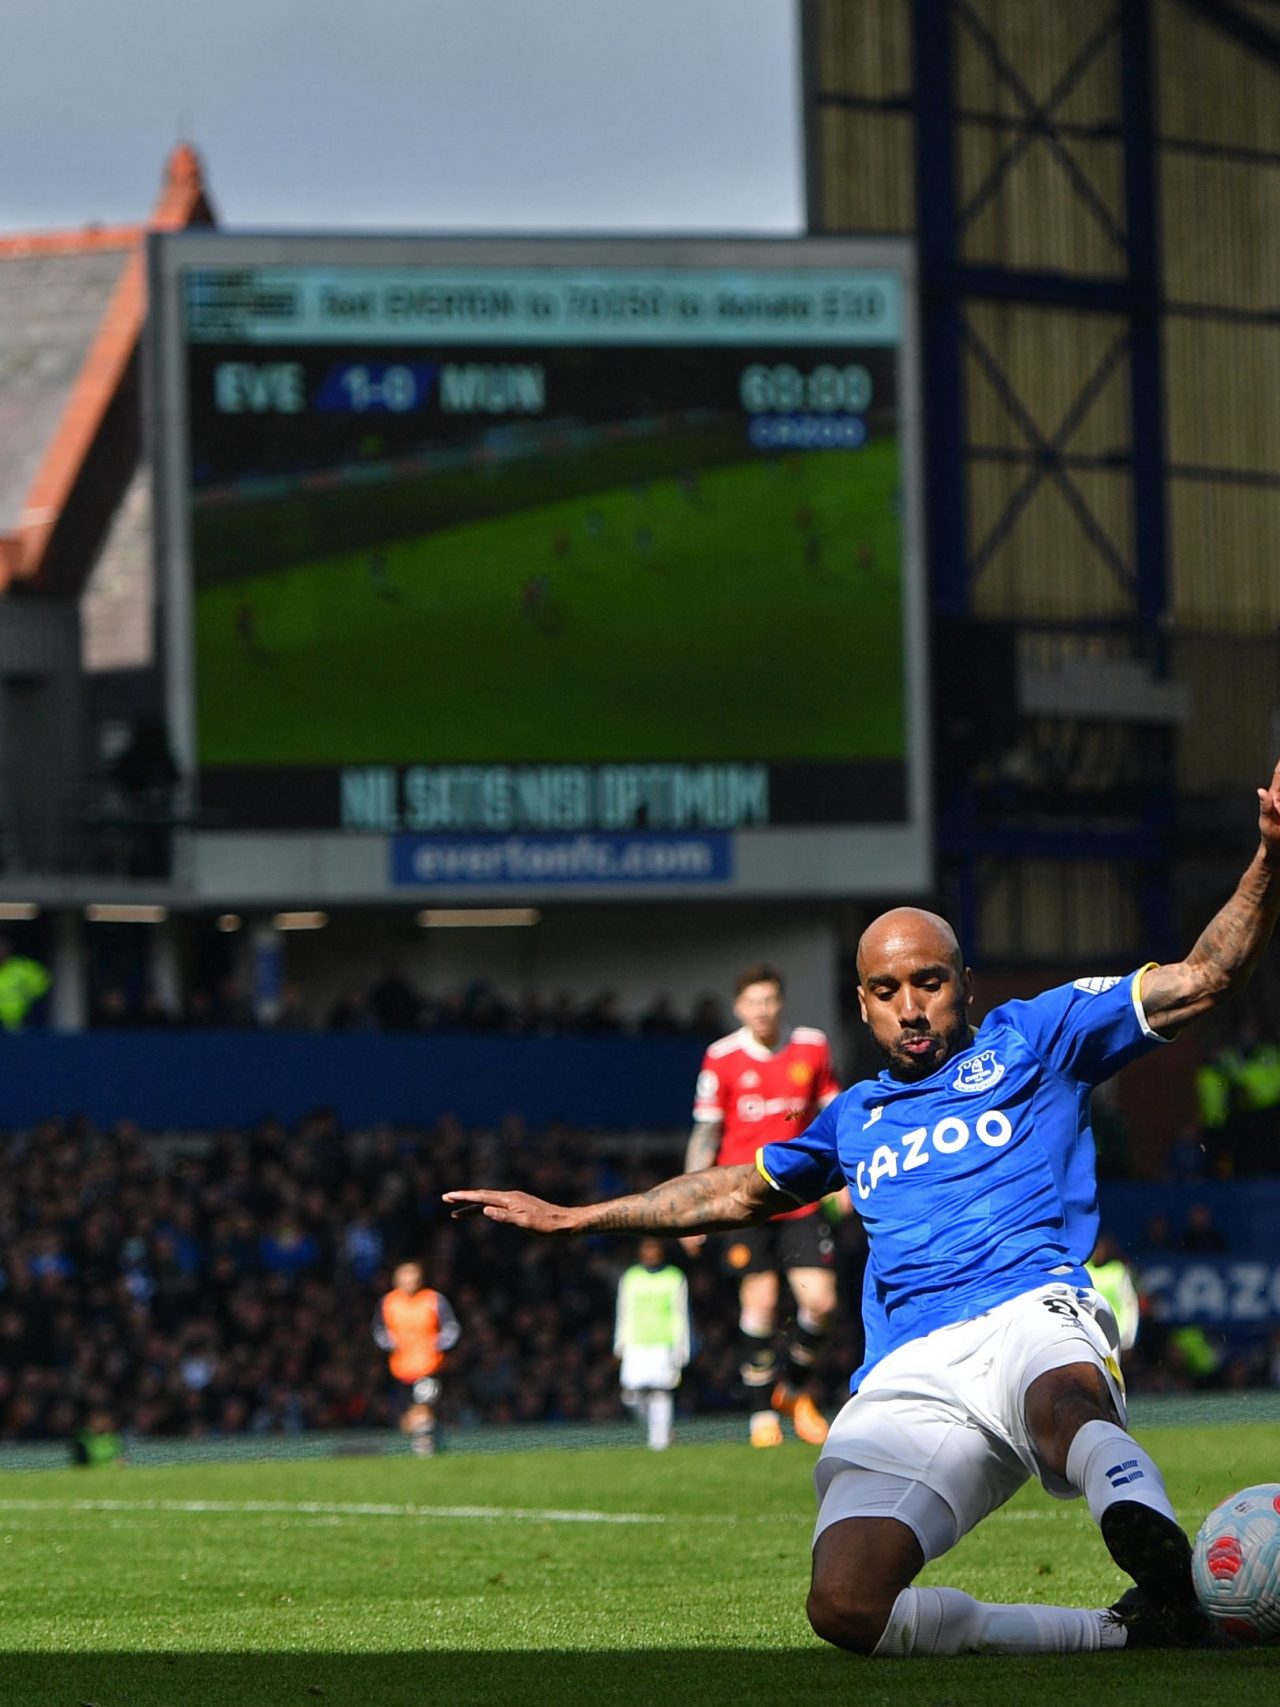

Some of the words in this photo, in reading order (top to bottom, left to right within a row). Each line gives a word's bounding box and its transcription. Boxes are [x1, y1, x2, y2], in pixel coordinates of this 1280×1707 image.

[213, 362, 305, 414] EVE
[339, 364, 418, 412] 1-0
[438, 362, 546, 414] MUN
[411, 837, 713, 880] evertonfc.com
[857, 1110, 1013, 1201] CAZOO
